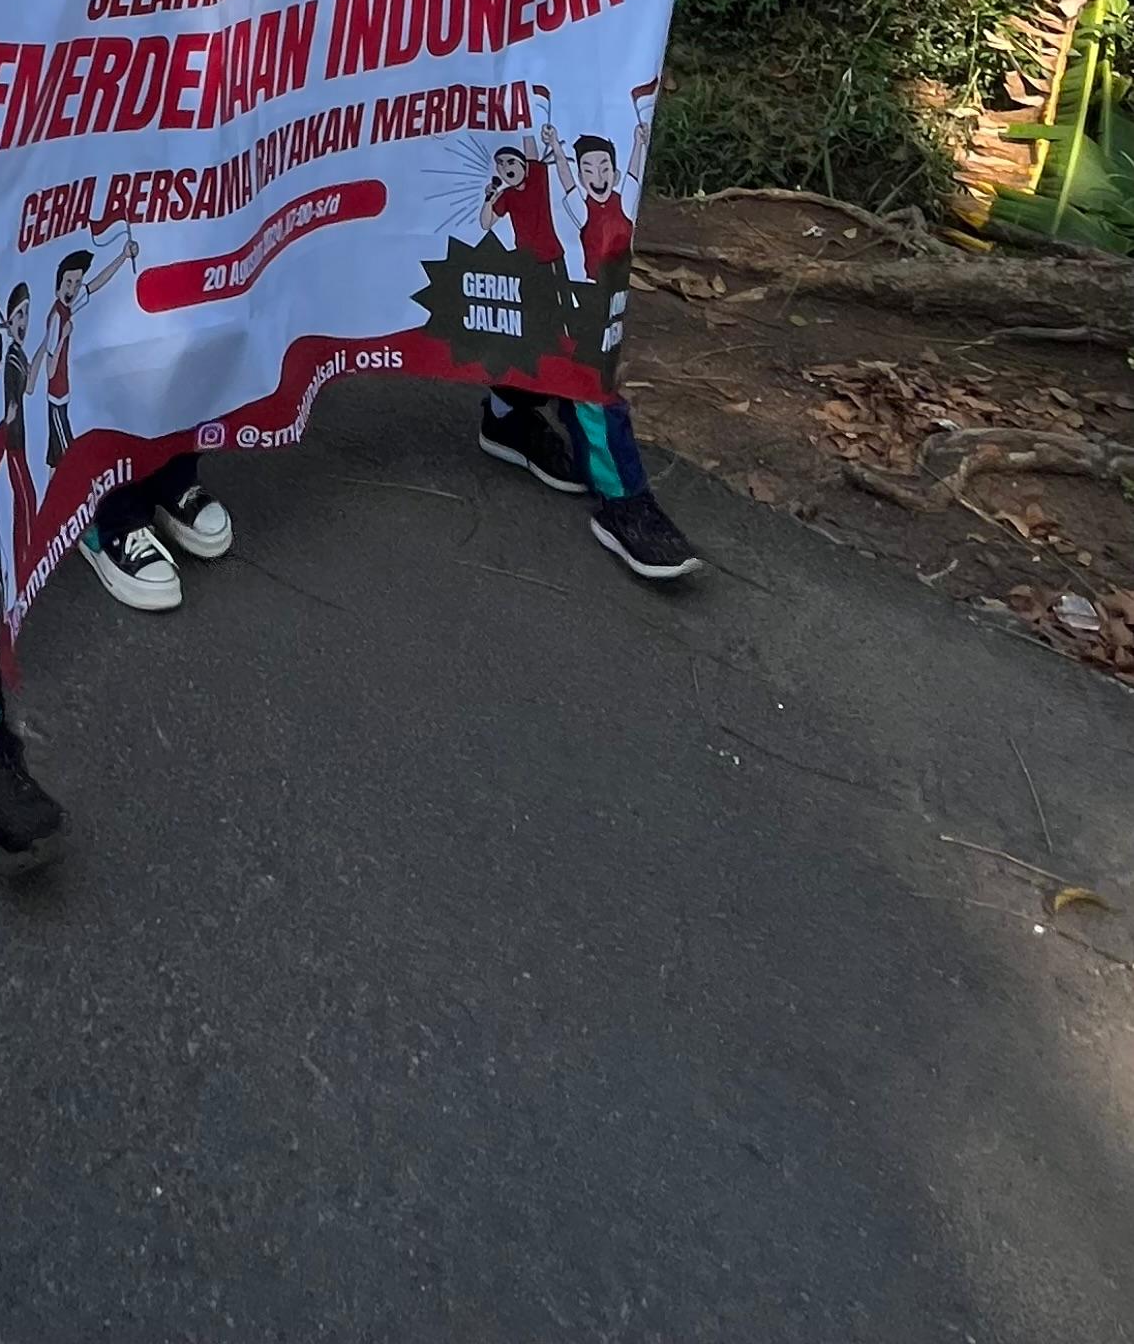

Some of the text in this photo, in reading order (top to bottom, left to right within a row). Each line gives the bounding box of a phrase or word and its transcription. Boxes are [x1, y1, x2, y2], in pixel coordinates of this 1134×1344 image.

[18, 81, 532, 253] CERIA BERSAMA RAYAKAN MERDEKA
[203, 264, 227, 292] 20
[462, 272, 522, 303] GERAK
[463, 304, 522, 337] JALAN
